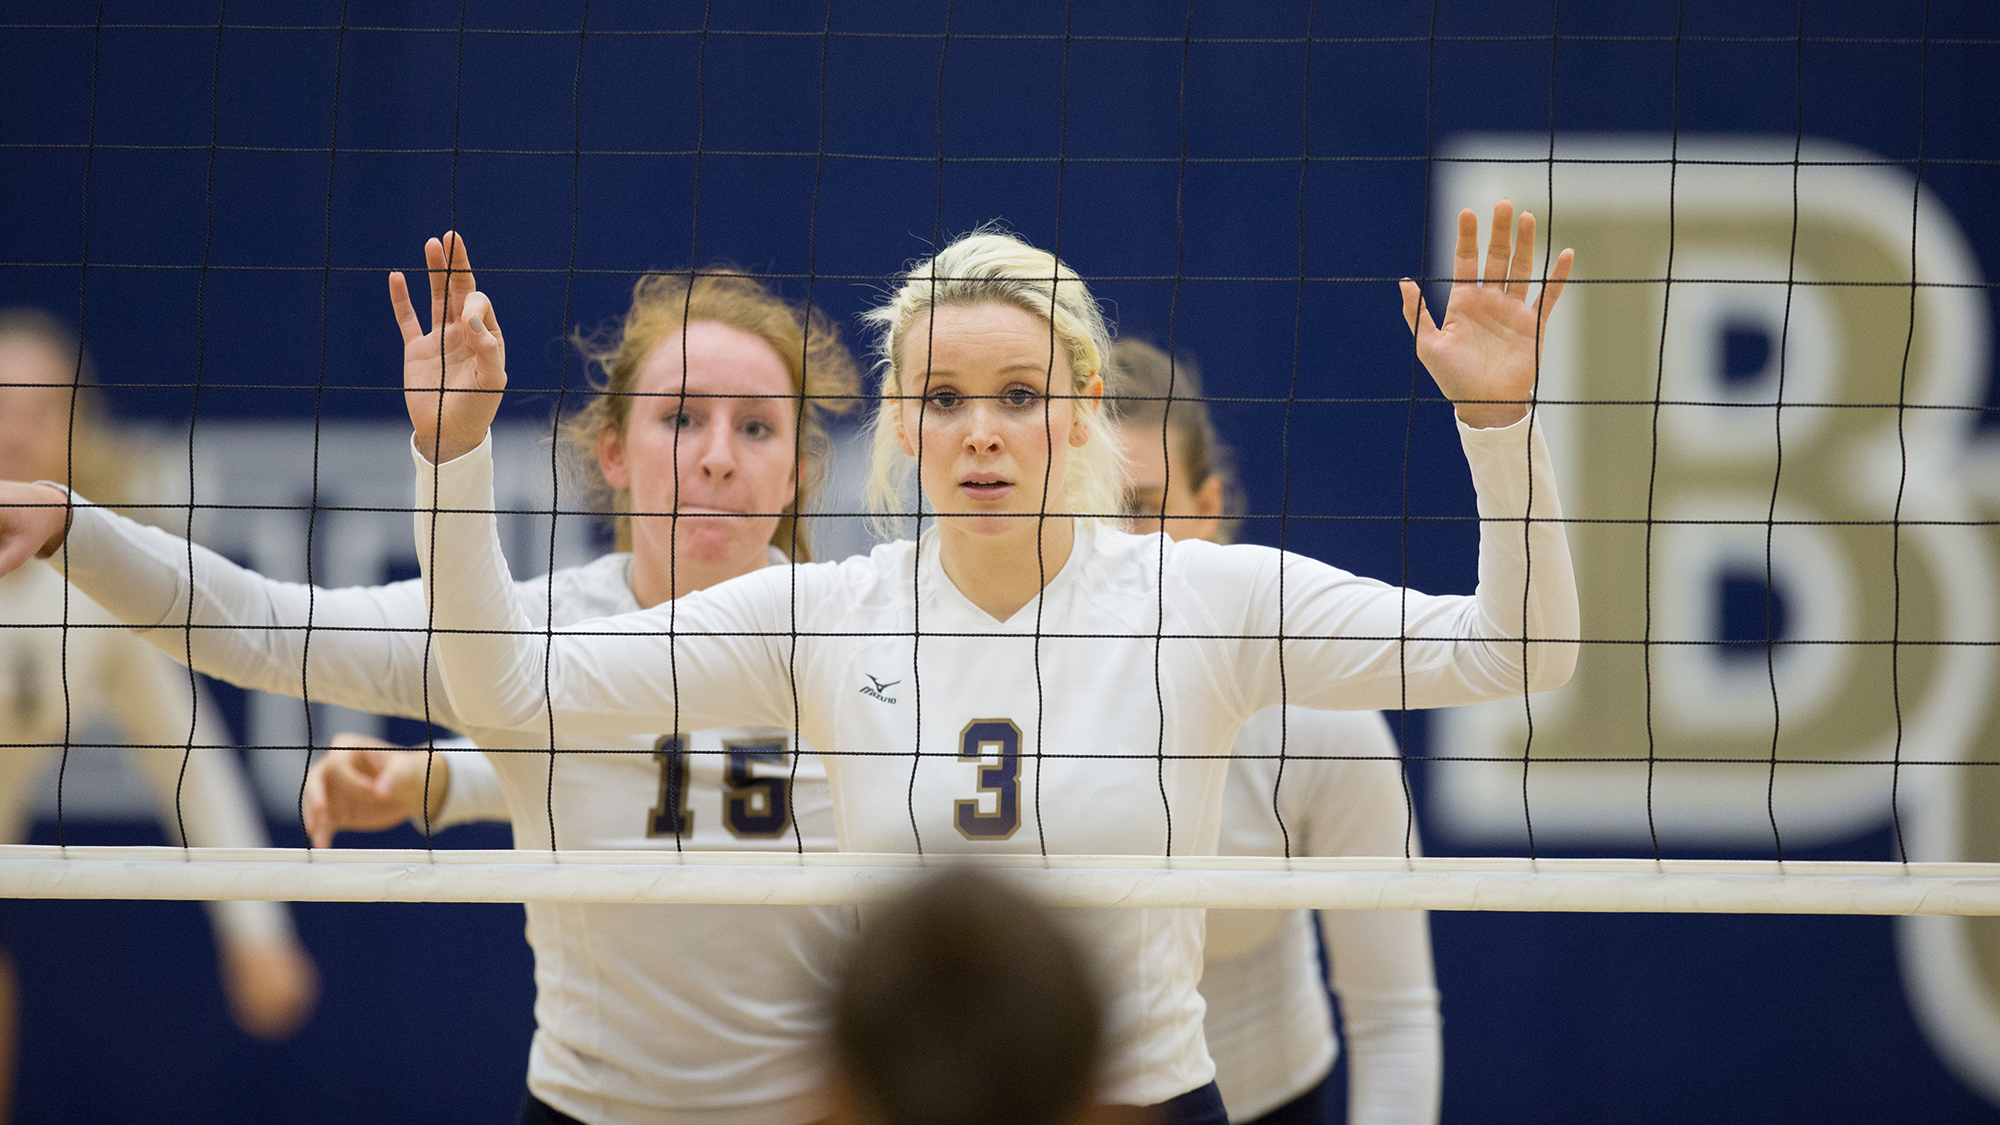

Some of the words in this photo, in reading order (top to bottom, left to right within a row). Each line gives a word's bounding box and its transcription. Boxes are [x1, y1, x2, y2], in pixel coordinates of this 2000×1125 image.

[1432, 133, 1992, 844] B
[646, 733, 792, 840] 15
[953, 717, 1023, 841] 3
